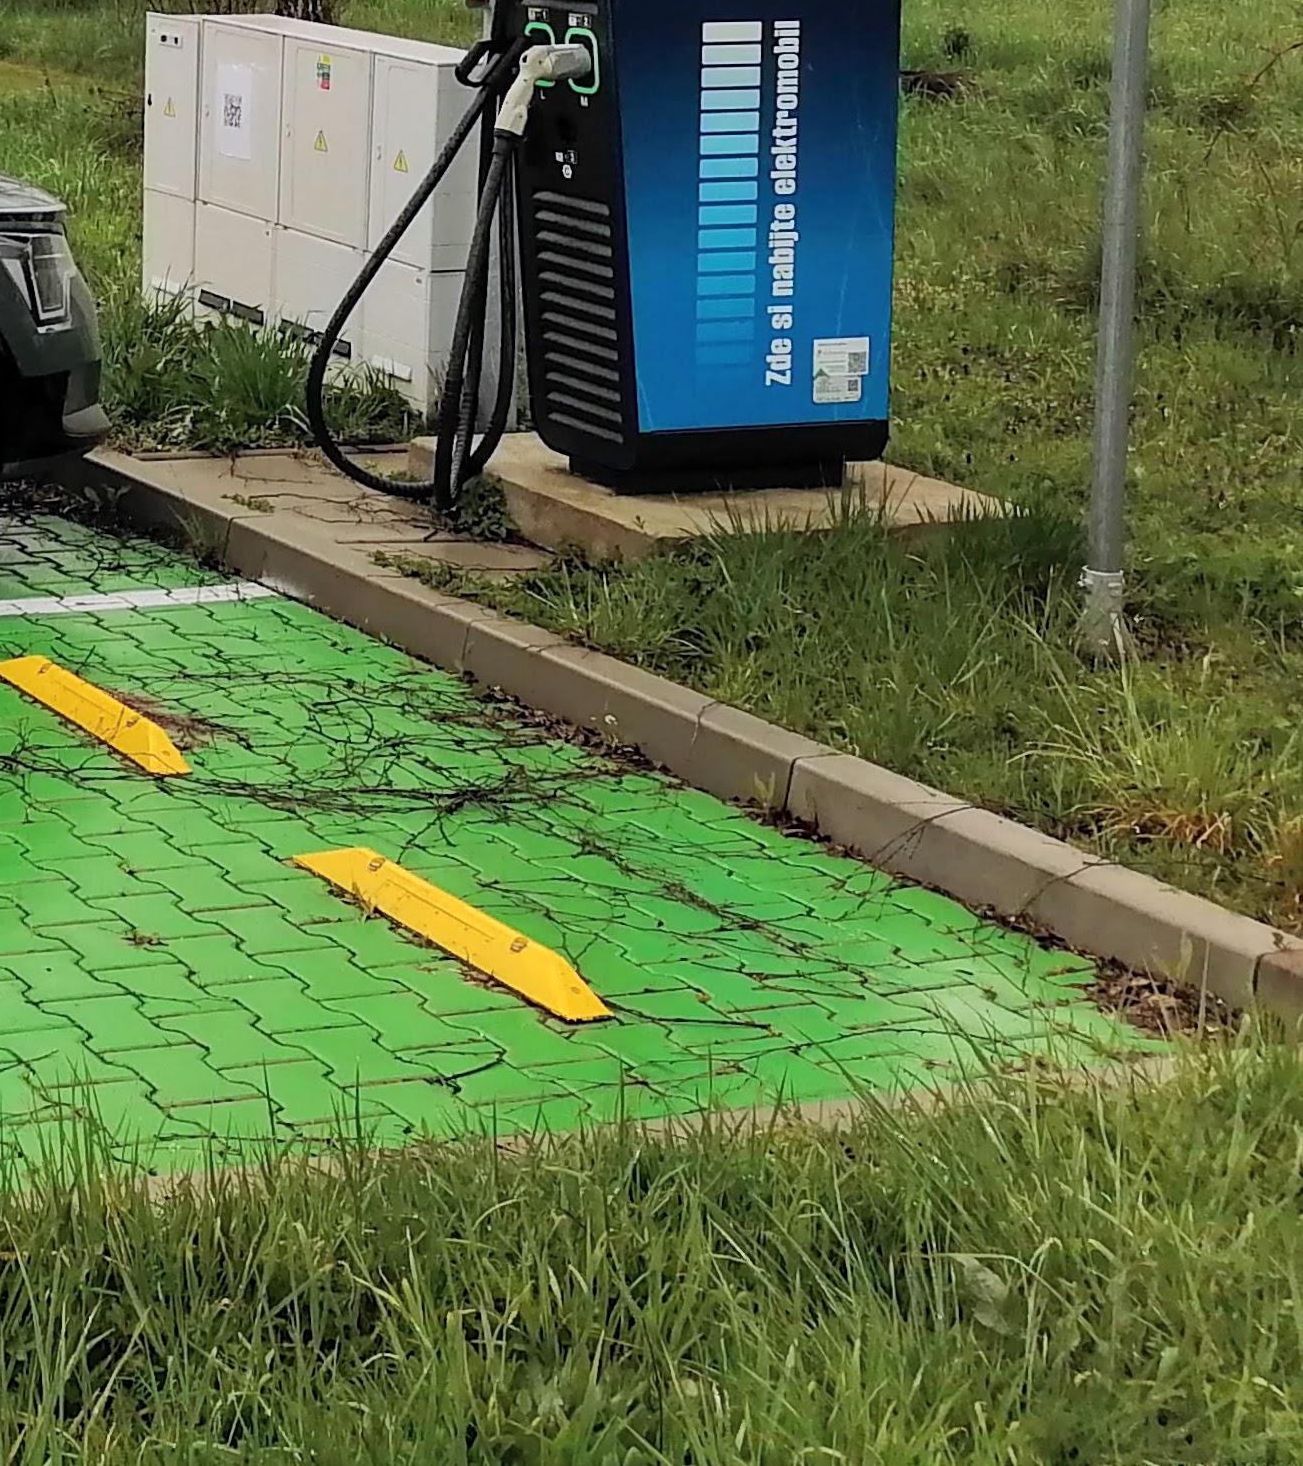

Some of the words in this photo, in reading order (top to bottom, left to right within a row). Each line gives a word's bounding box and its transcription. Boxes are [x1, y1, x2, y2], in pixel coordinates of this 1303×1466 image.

[770, 20, 801, 196] elektromobil
[768, 203, 799, 297] nabijte
[767, 305, 793, 330] si
[765, 338, 792, 387] Zde
